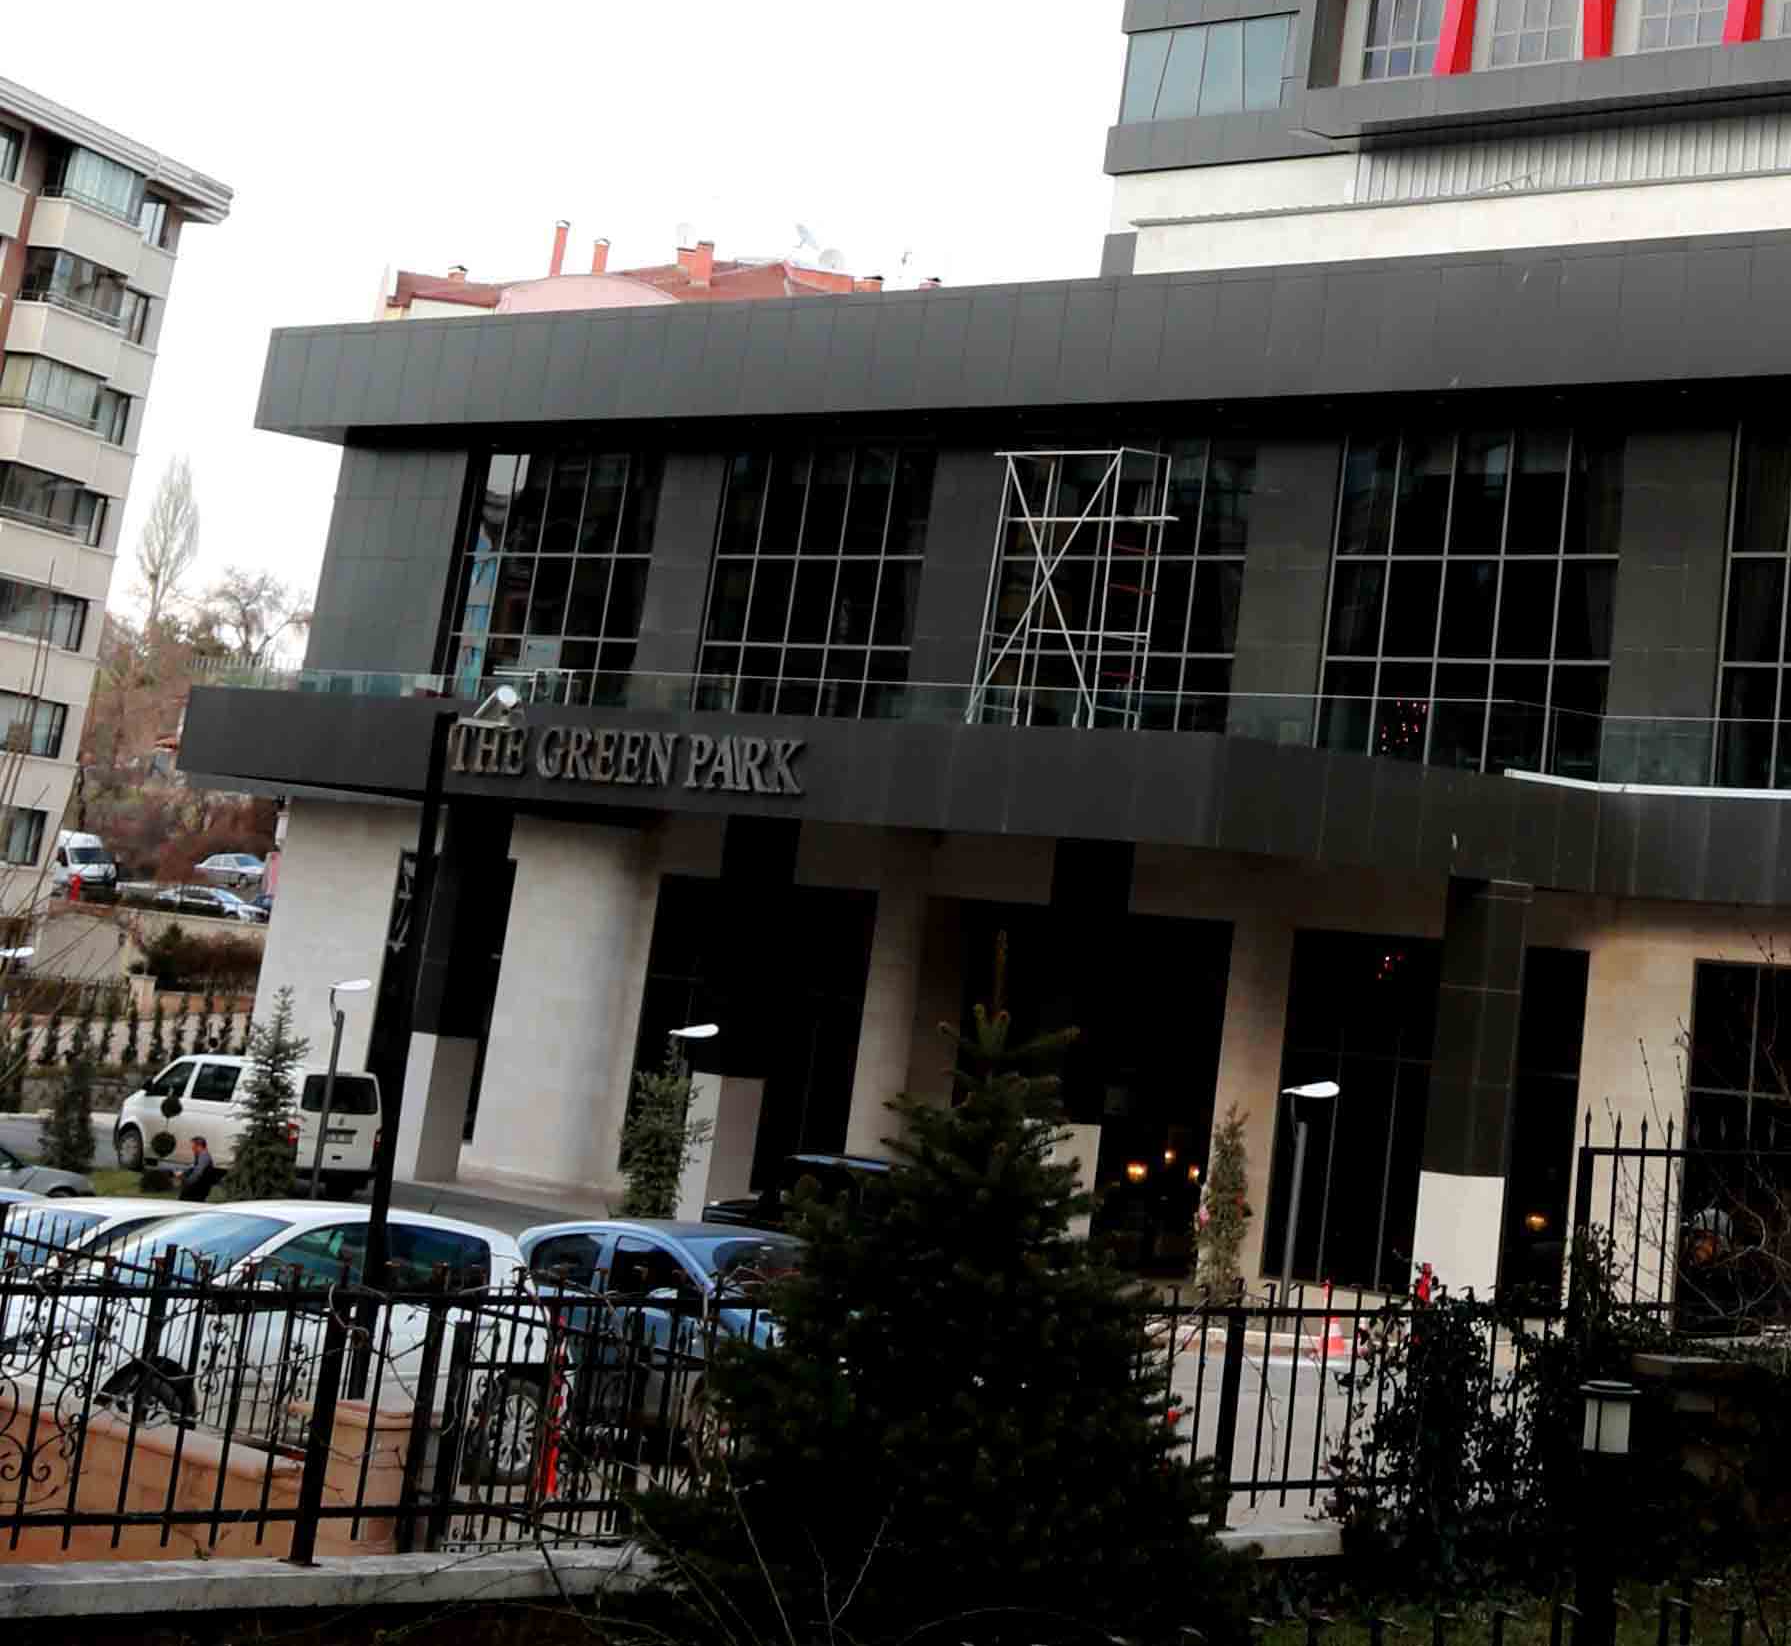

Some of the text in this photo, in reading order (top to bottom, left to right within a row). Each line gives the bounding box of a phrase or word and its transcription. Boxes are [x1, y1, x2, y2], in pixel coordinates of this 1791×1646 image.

[449, 723, 805, 795] THE GREEN PARK
